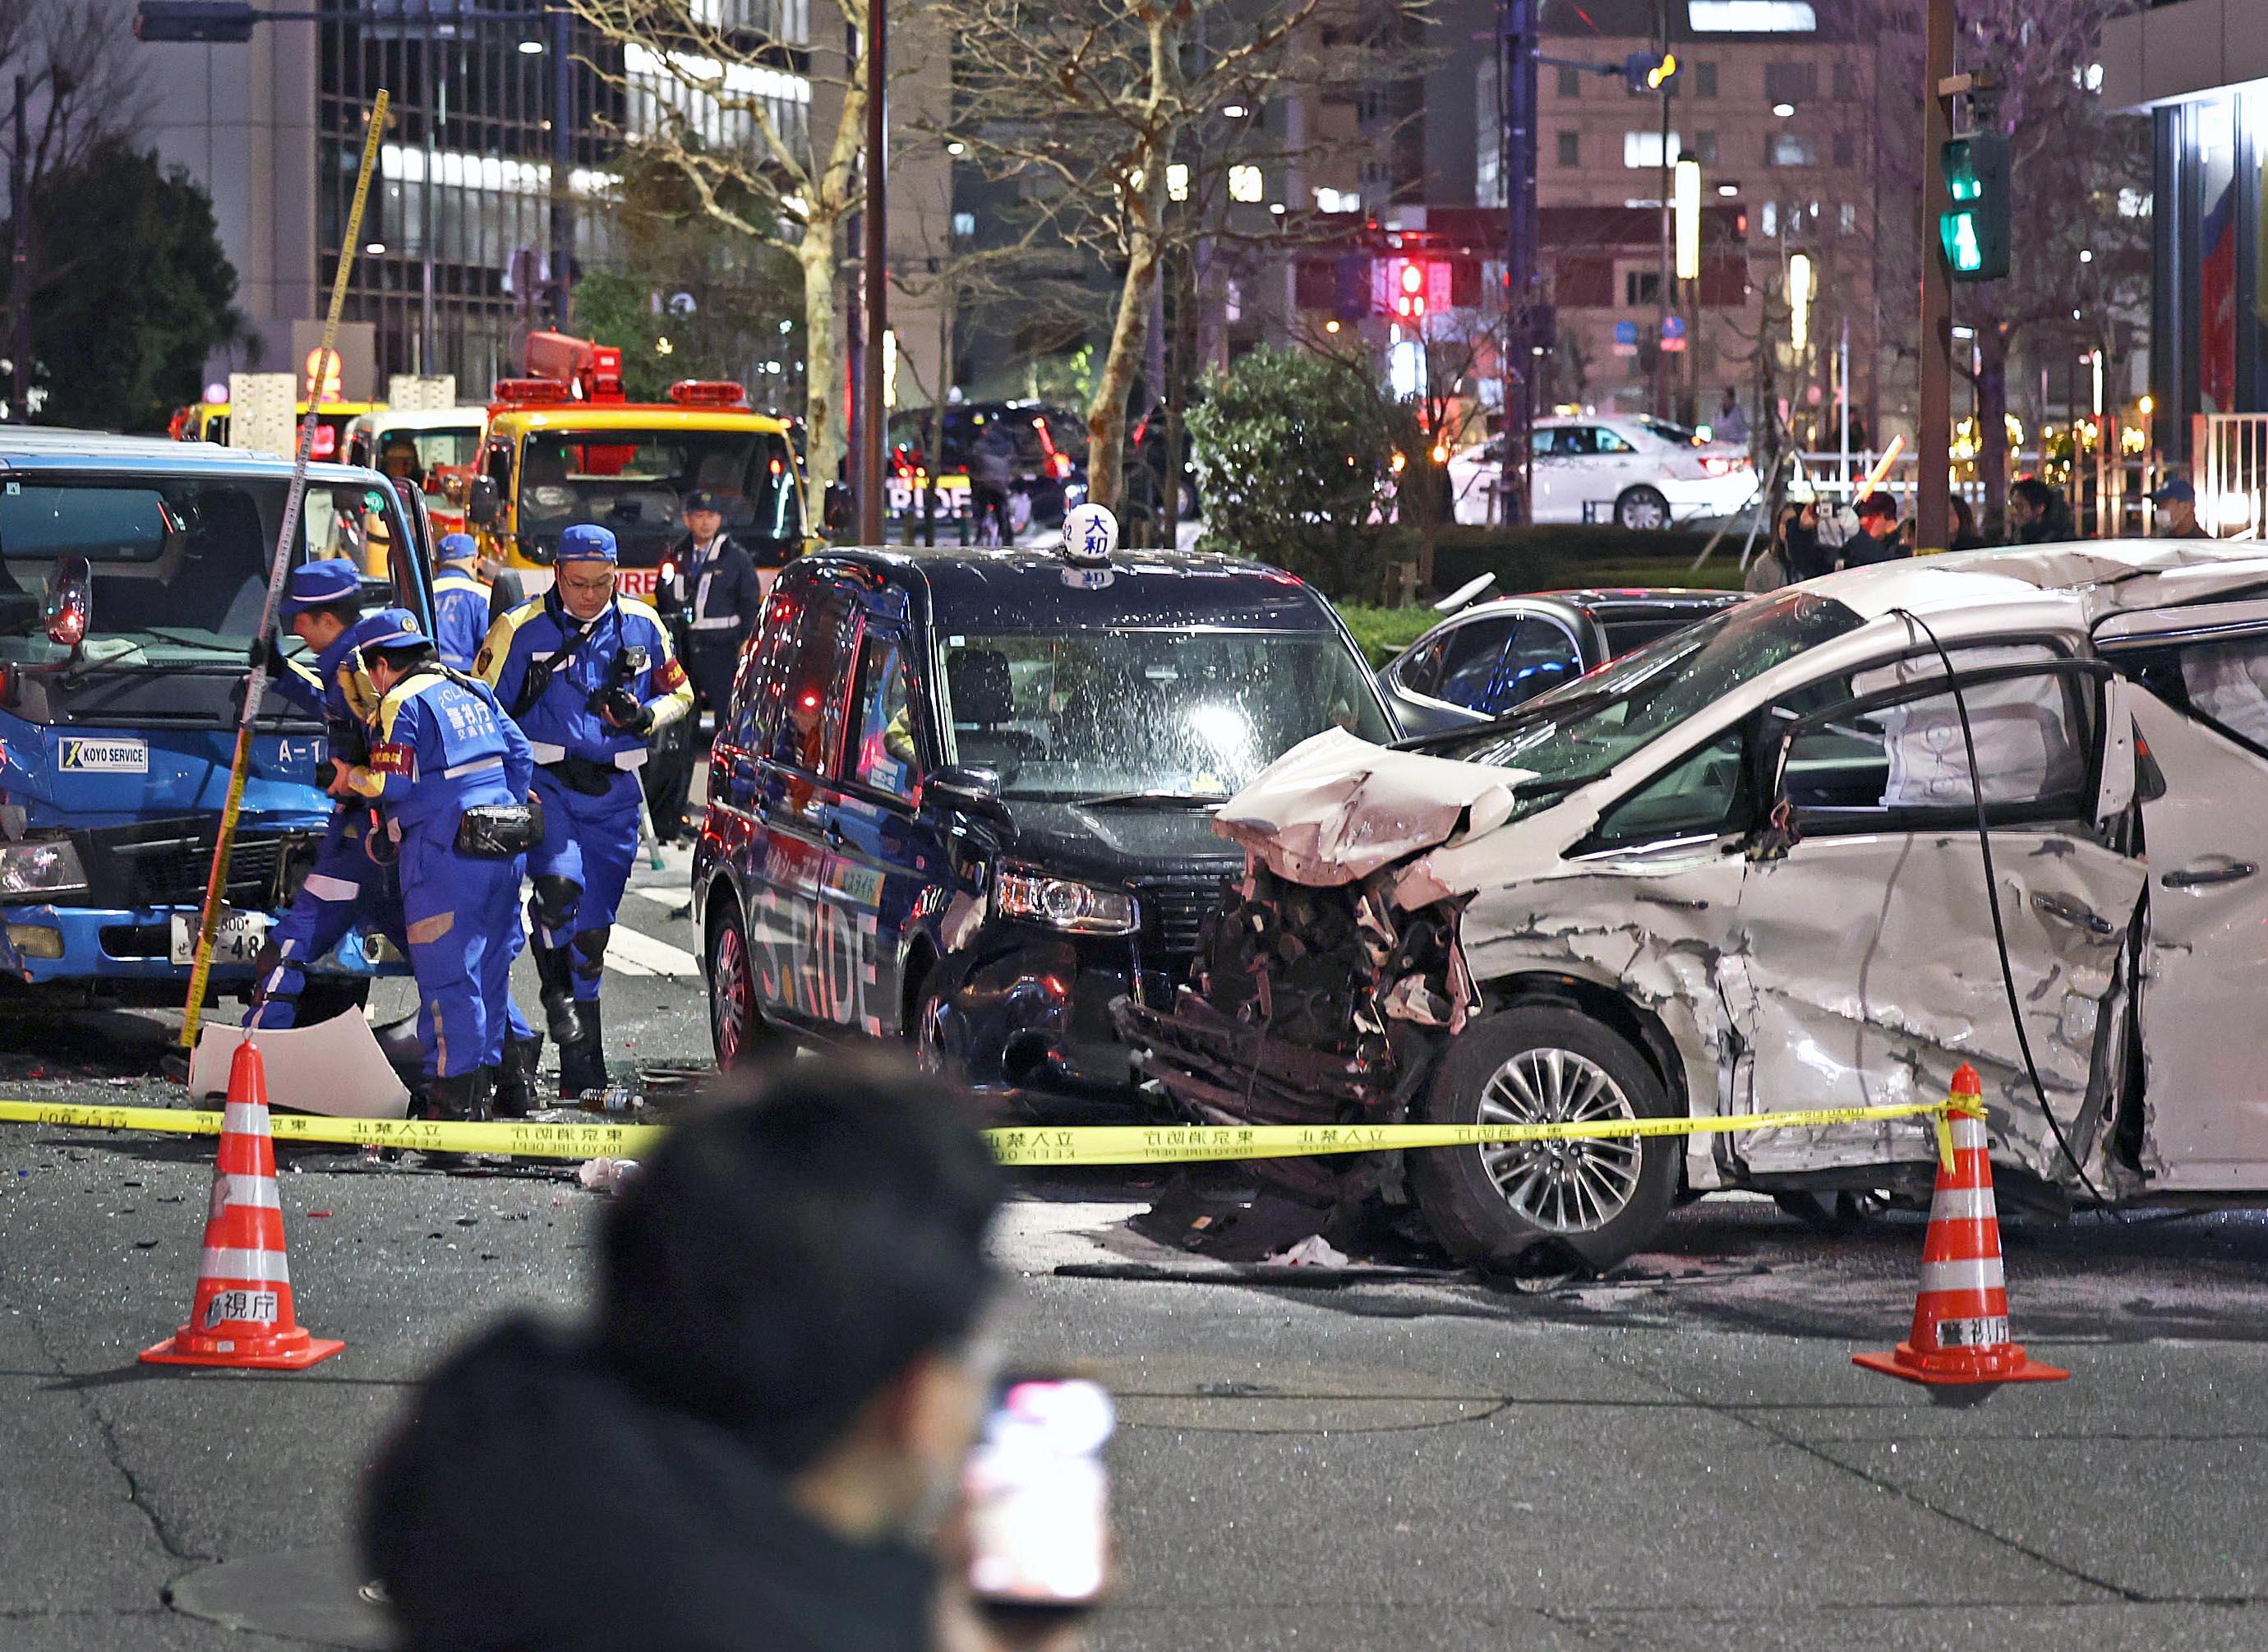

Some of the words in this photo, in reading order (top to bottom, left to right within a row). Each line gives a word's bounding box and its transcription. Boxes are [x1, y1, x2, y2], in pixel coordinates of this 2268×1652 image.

[1083, 515, 1108, 555] 大和
[84, 748, 107, 762] KOYO
[109, 748, 143, 763] SERVICE
